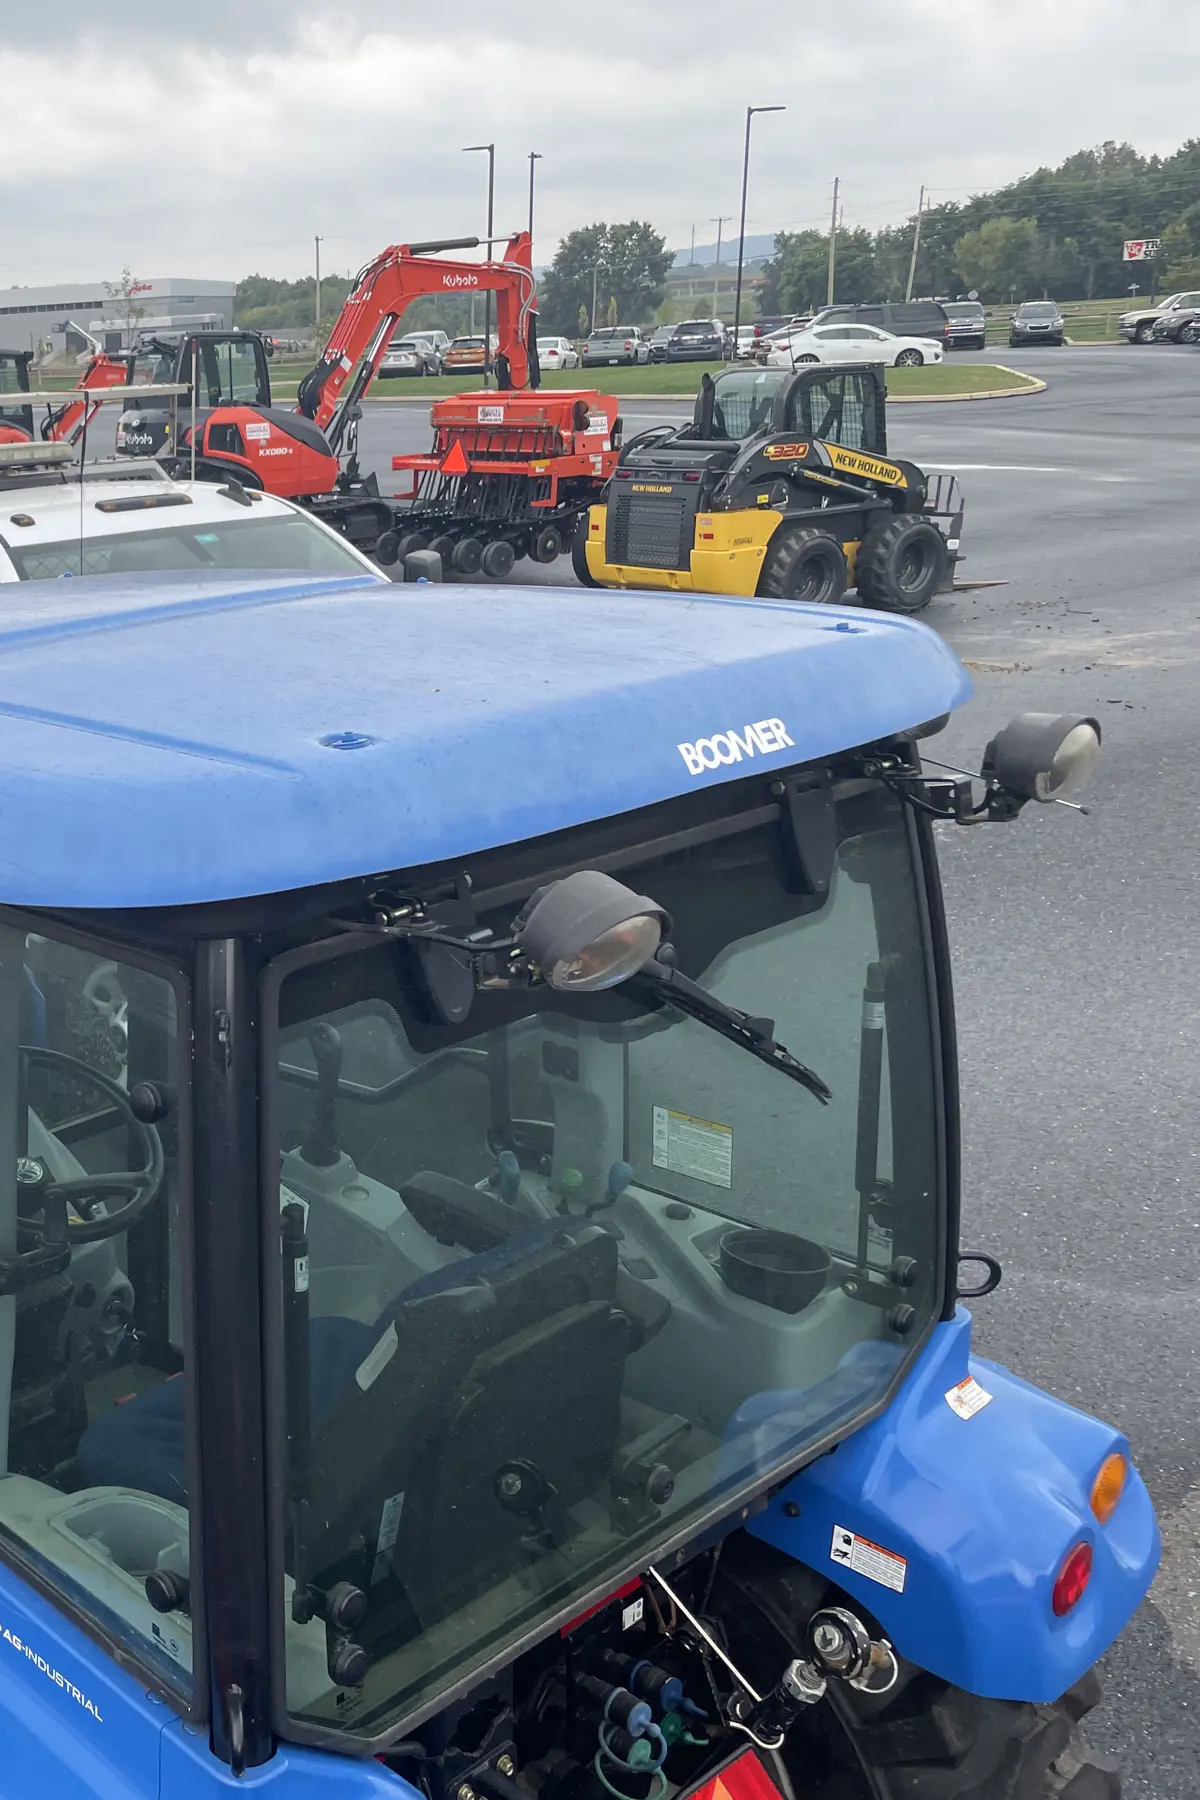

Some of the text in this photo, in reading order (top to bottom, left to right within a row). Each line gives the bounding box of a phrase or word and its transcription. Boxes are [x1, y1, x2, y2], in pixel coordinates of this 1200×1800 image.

[1126, 242, 1142, 256] TSC
[442, 273, 478, 287] Kubota
[126, 433, 153, 445] Kubota
[764, 444, 808, 458] L320
[835, 453, 856, 468] NEW
[857, 459, 897, 481] HOLLAND
[632, 484, 672, 494] NEW HOLLAND
[677, 717, 796, 775] BOOMER
[2, 1628, 104, 1722] AG-INDUSTRIAL
